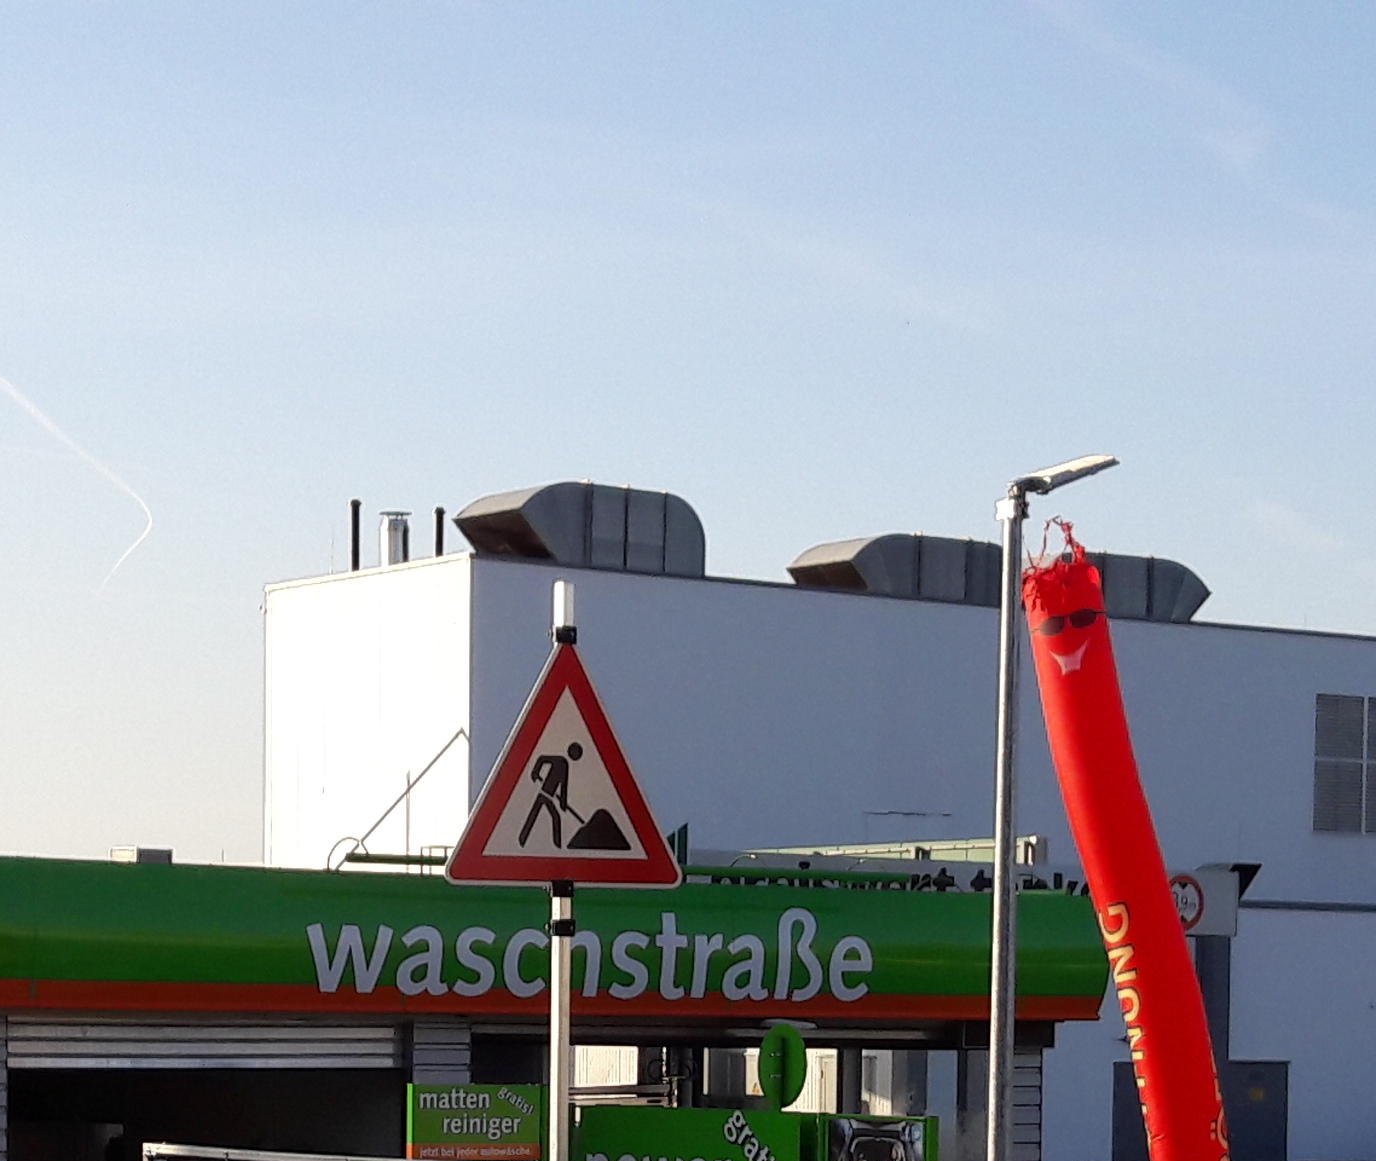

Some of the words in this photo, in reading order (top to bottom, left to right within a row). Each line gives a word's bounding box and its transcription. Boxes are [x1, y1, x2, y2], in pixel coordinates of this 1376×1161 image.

[419, 1088, 491, 1109] matten
[497, 1087, 535, 1116] gratis!
[443, 1113, 521, 1140] reiniger
